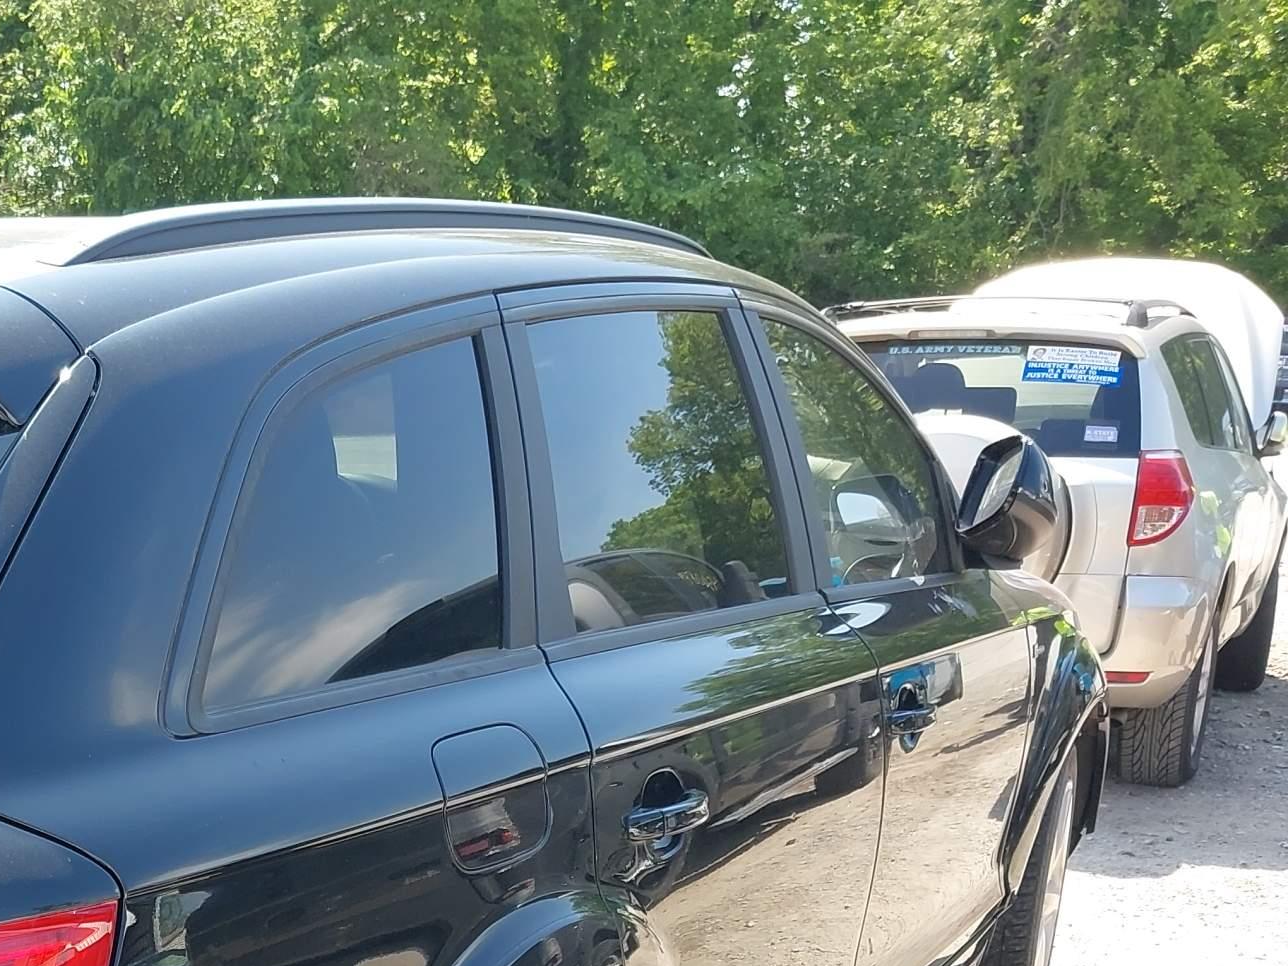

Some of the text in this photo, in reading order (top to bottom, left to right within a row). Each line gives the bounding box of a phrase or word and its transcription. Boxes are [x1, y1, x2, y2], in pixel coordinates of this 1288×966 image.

[889, 345, 1022, 355] U.S. ARMY VETERAN
[1028, 362, 1120, 373] INJUSTICE ANYWHERE
[1062, 373, 1118, 383] EVERYWHERE
